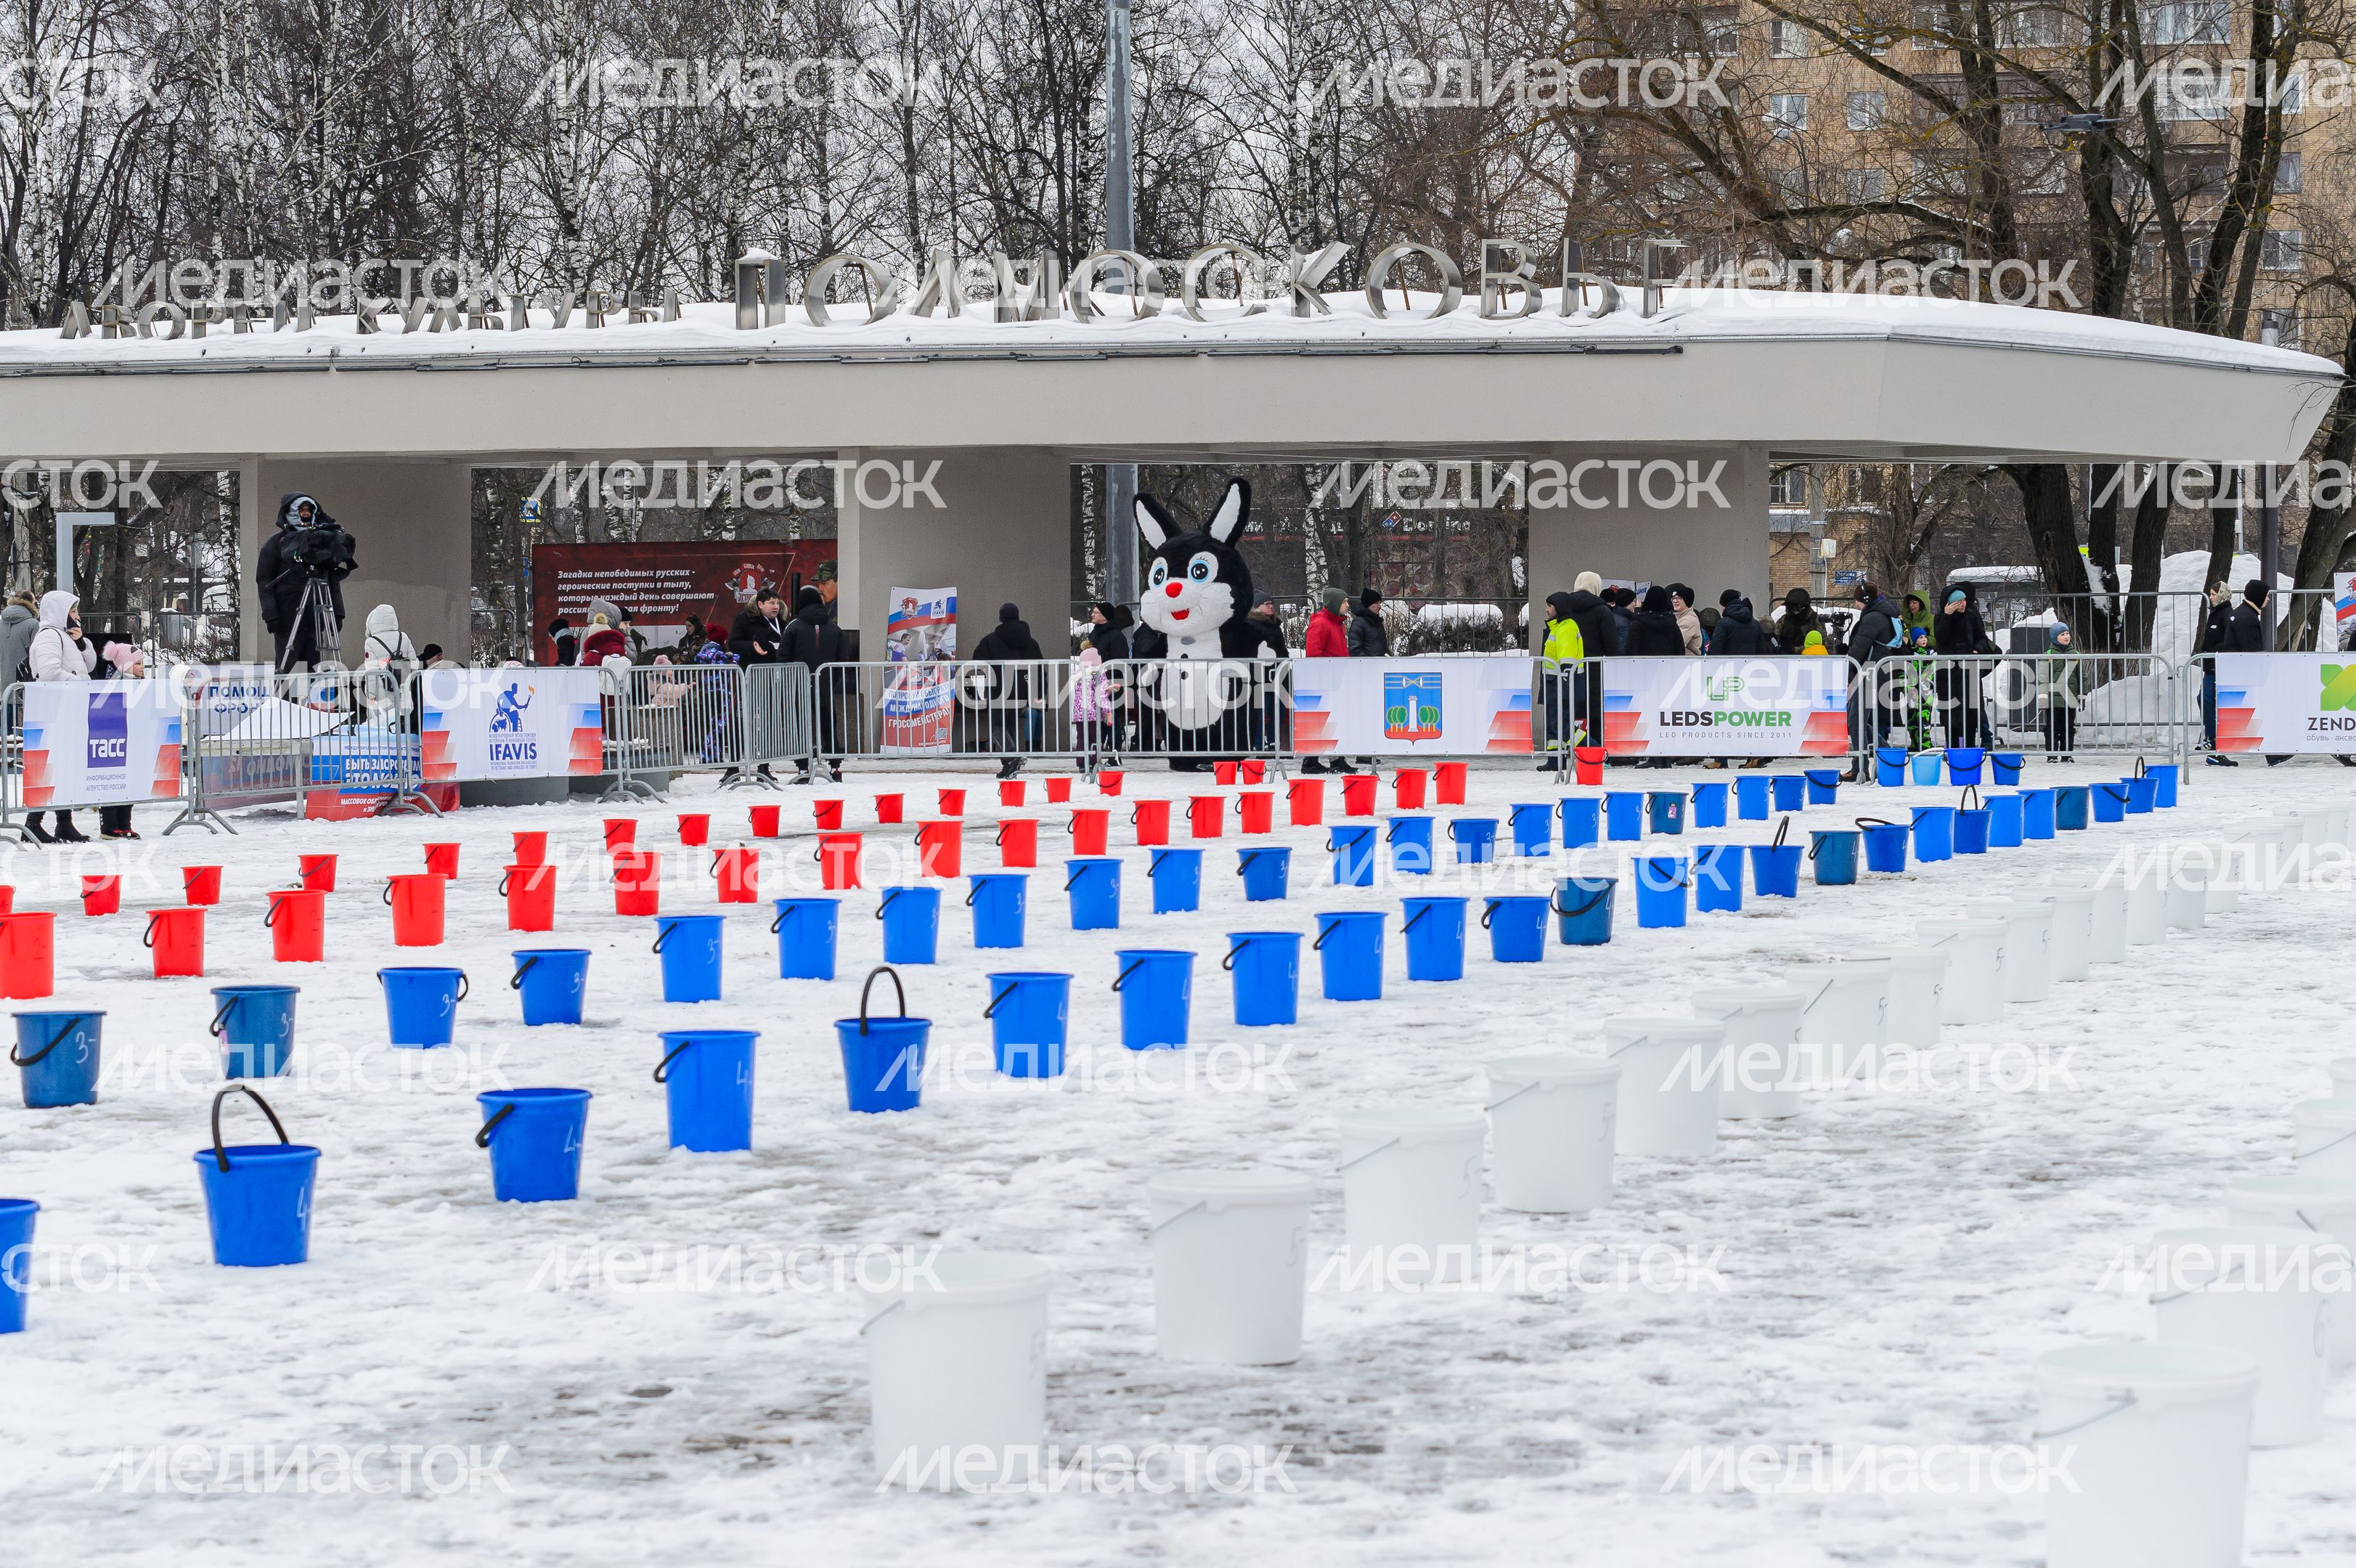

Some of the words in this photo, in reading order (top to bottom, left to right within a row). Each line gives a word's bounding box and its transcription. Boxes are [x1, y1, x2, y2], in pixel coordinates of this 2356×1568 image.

[356, 290, 678, 334] КУЛЬТУРЫ
[595, 569, 654, 578] непобедимых
[656, 569, 690, 579] русских
[558, 583, 610, 592] героические
[664, 581, 691, 590] тылу,
[558, 606, 593, 616] россия
[640, 604, 679, 614] фронту!
[215, 702, 264, 714] ФРОН
[1660, 711, 1792, 727] LEDSPOWER
[2307, 717, 2356, 731] ZEND
[2307, 732, 2329, 742] обувь
[489, 743, 537, 761] IFAVIS
[76, 1031, 97, 1063] 3-
